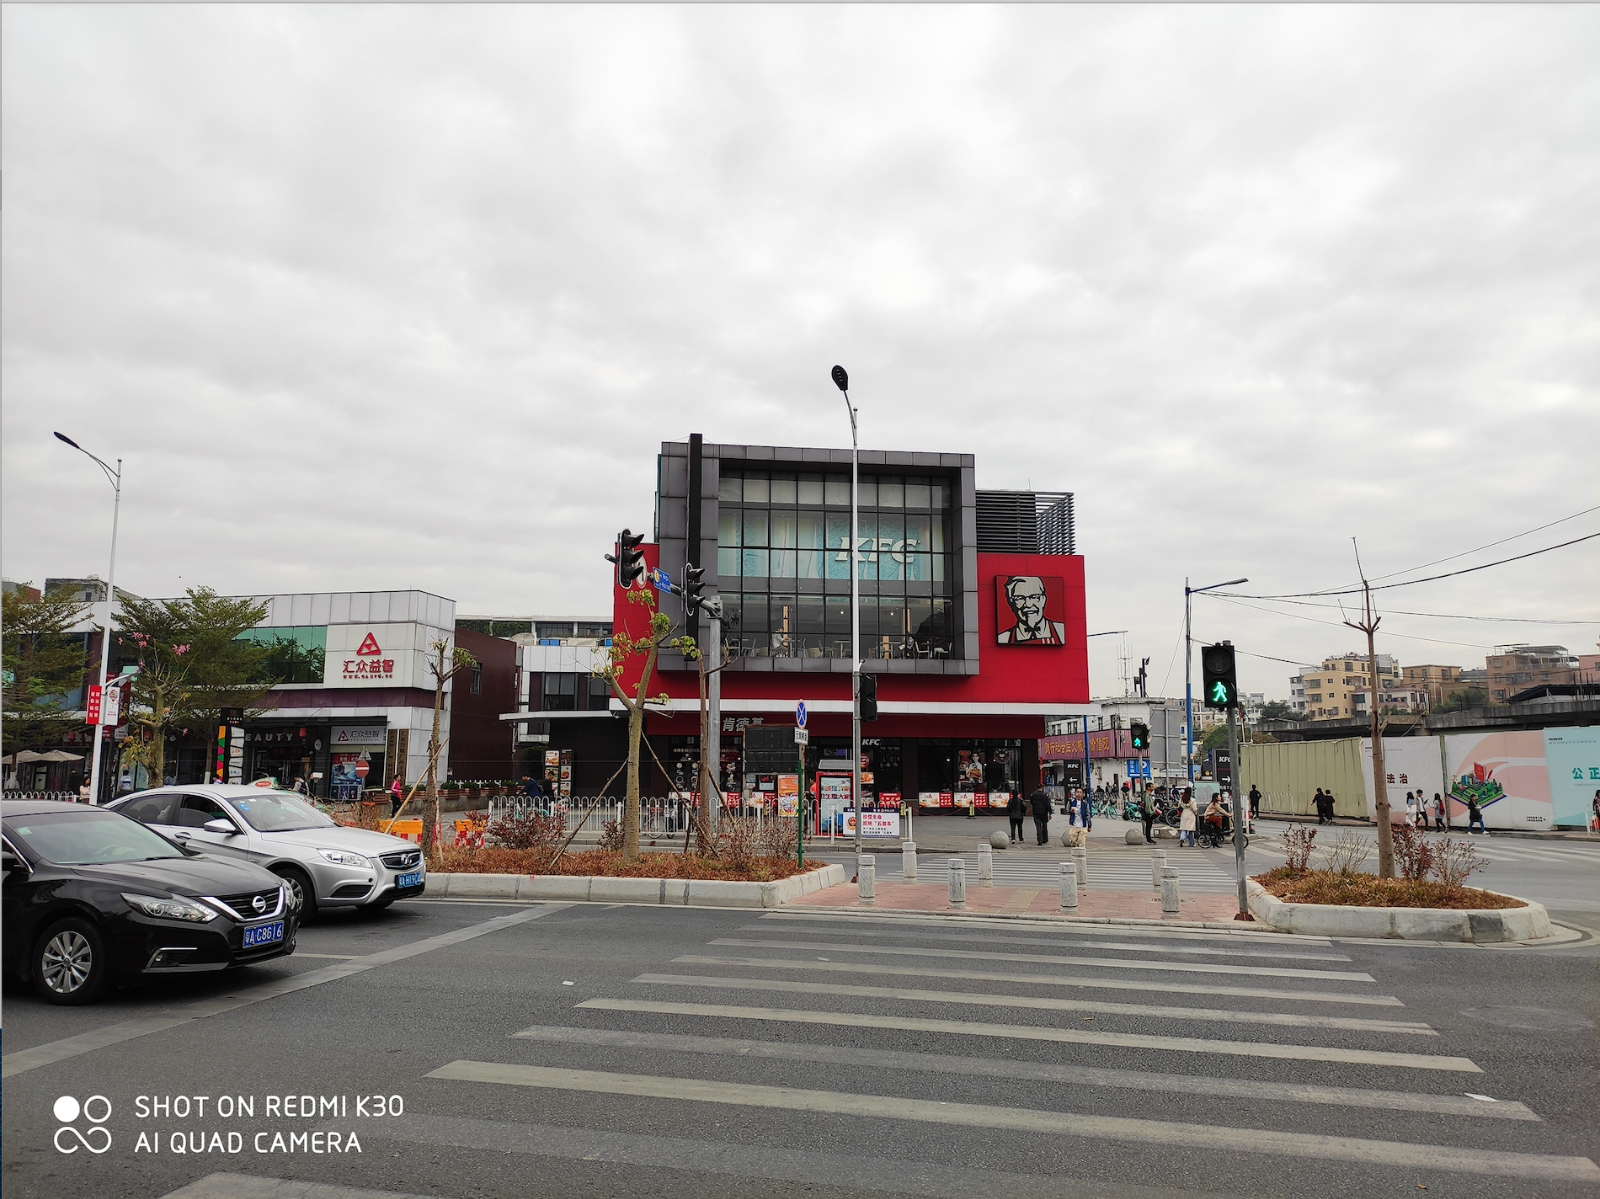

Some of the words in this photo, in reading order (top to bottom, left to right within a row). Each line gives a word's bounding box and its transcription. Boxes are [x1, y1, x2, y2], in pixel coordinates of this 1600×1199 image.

[834, 537, 918, 563] KFC
[342, 658, 395, 673] 汇众益智
[349, 730, 380, 738] 汇众益智
[862, 738, 880, 746] KFC
[1044, 737, 1110, 755] 践行社会主义核价值观
[1386, 773, 1409, 784] 法治
[1571, 767, 1600, 780] 公正
